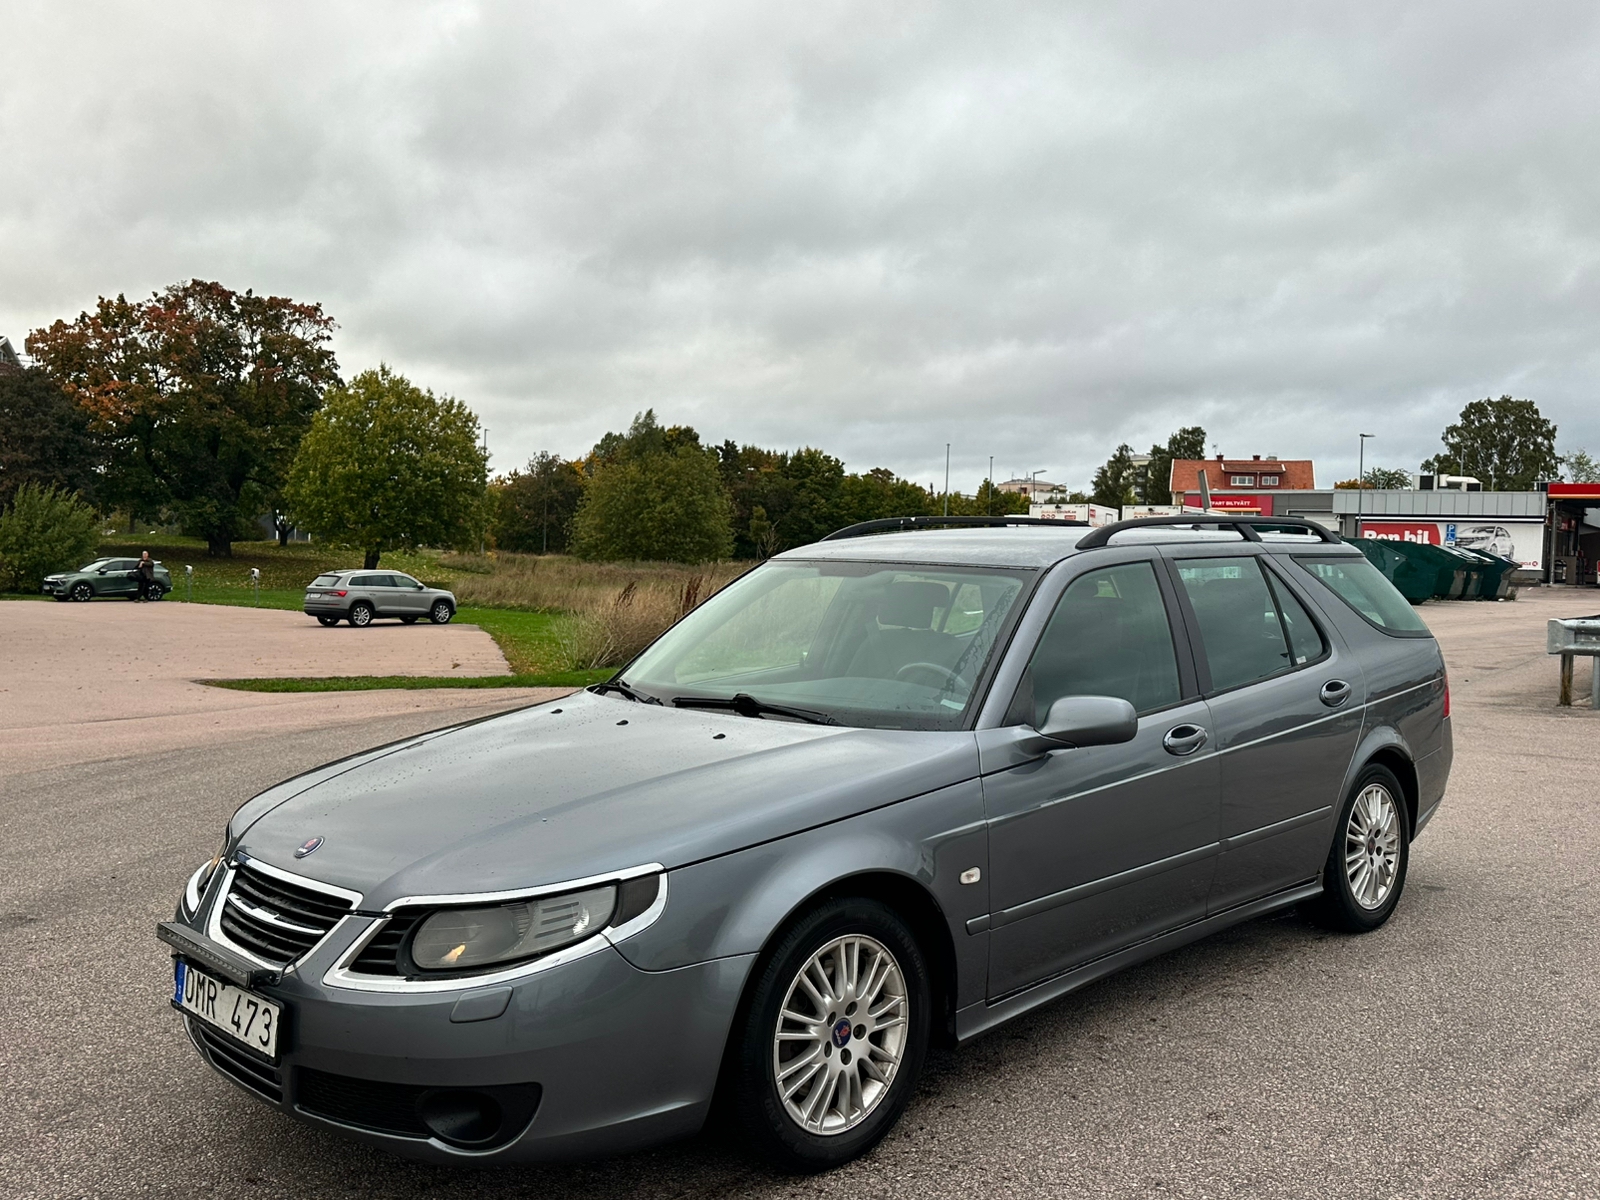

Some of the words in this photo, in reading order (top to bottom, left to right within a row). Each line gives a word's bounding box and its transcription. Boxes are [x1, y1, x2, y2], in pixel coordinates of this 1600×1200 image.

[1448, 524, 1455, 532] P
[1404, 529, 1431, 544] bil
[185, 968, 217, 1019] OMR
[231, 994, 272, 1046] 473
